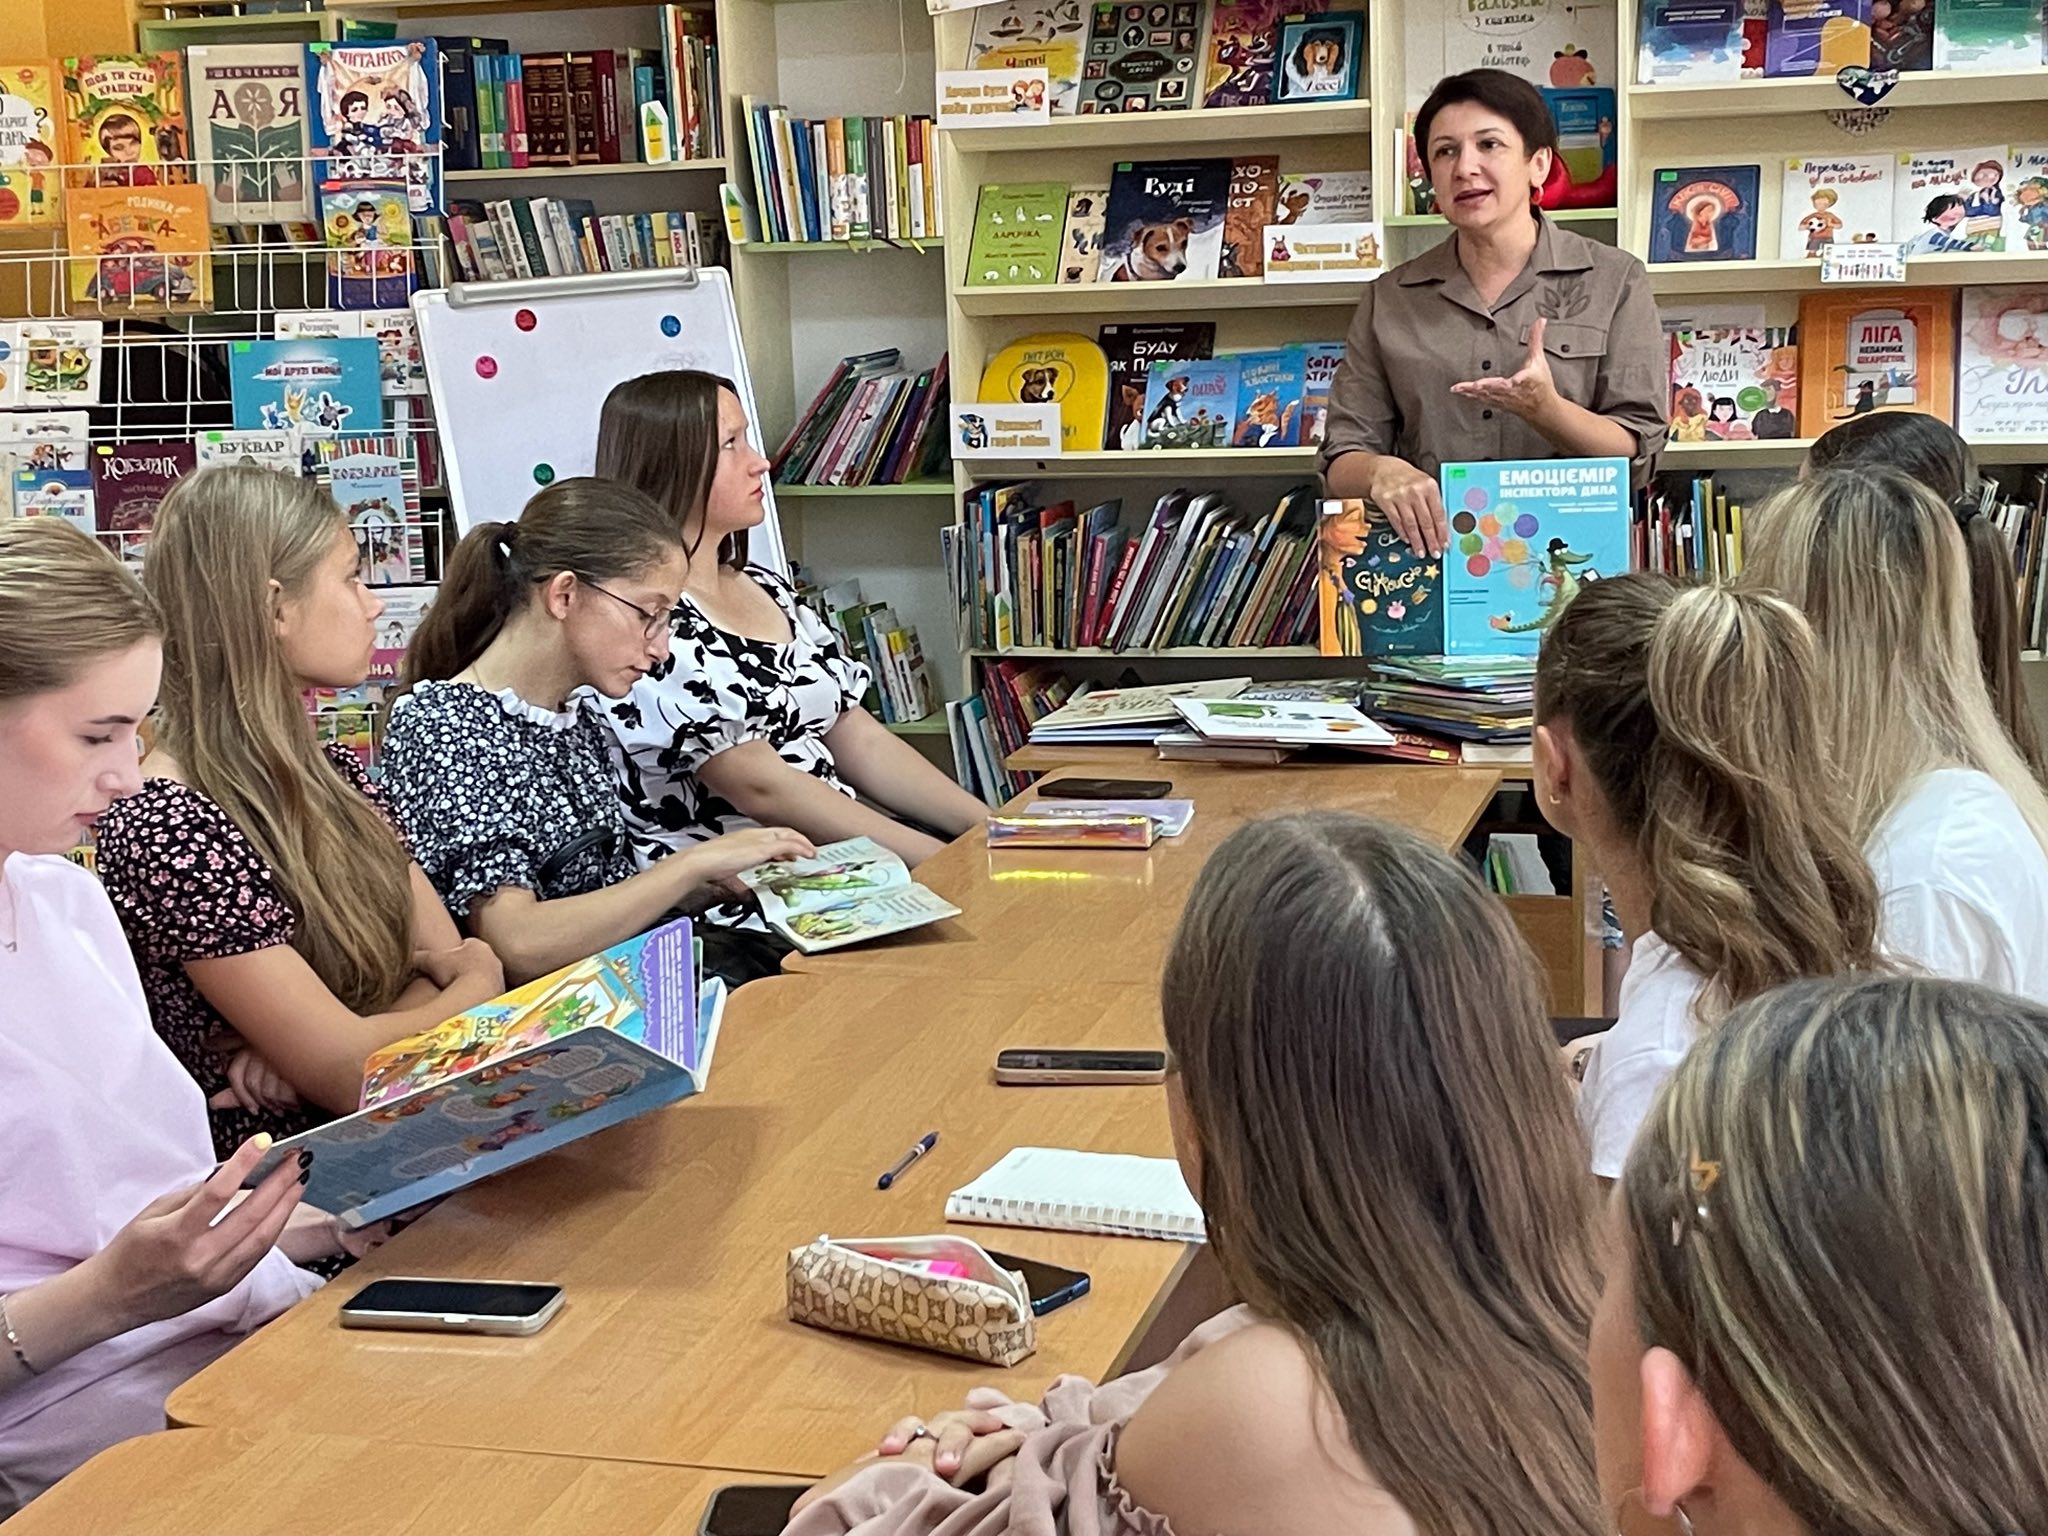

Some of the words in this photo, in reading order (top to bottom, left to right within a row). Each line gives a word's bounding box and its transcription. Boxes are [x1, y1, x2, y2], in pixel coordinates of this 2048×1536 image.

[339, 50, 407, 69] ЧИТАНКА
[214, 67, 292, 78] ШЕВЧЕНКО
[99, 83, 143, 96] КРАЩИМ
[209, 89, 236, 119] А
[278, 87, 301, 118] Я
[1861, 325, 1903, 343] ЛІГА
[1133, 341, 1178, 355] БУДУ
[219, 441, 284, 454] БУКВАР
[1500, 467, 1618, 486] ЕМОЦІЄМІР
[1500, 486, 1577, 498] ІНСПЕКТОРА
[1580, 485, 1618, 498] ДИЛА
